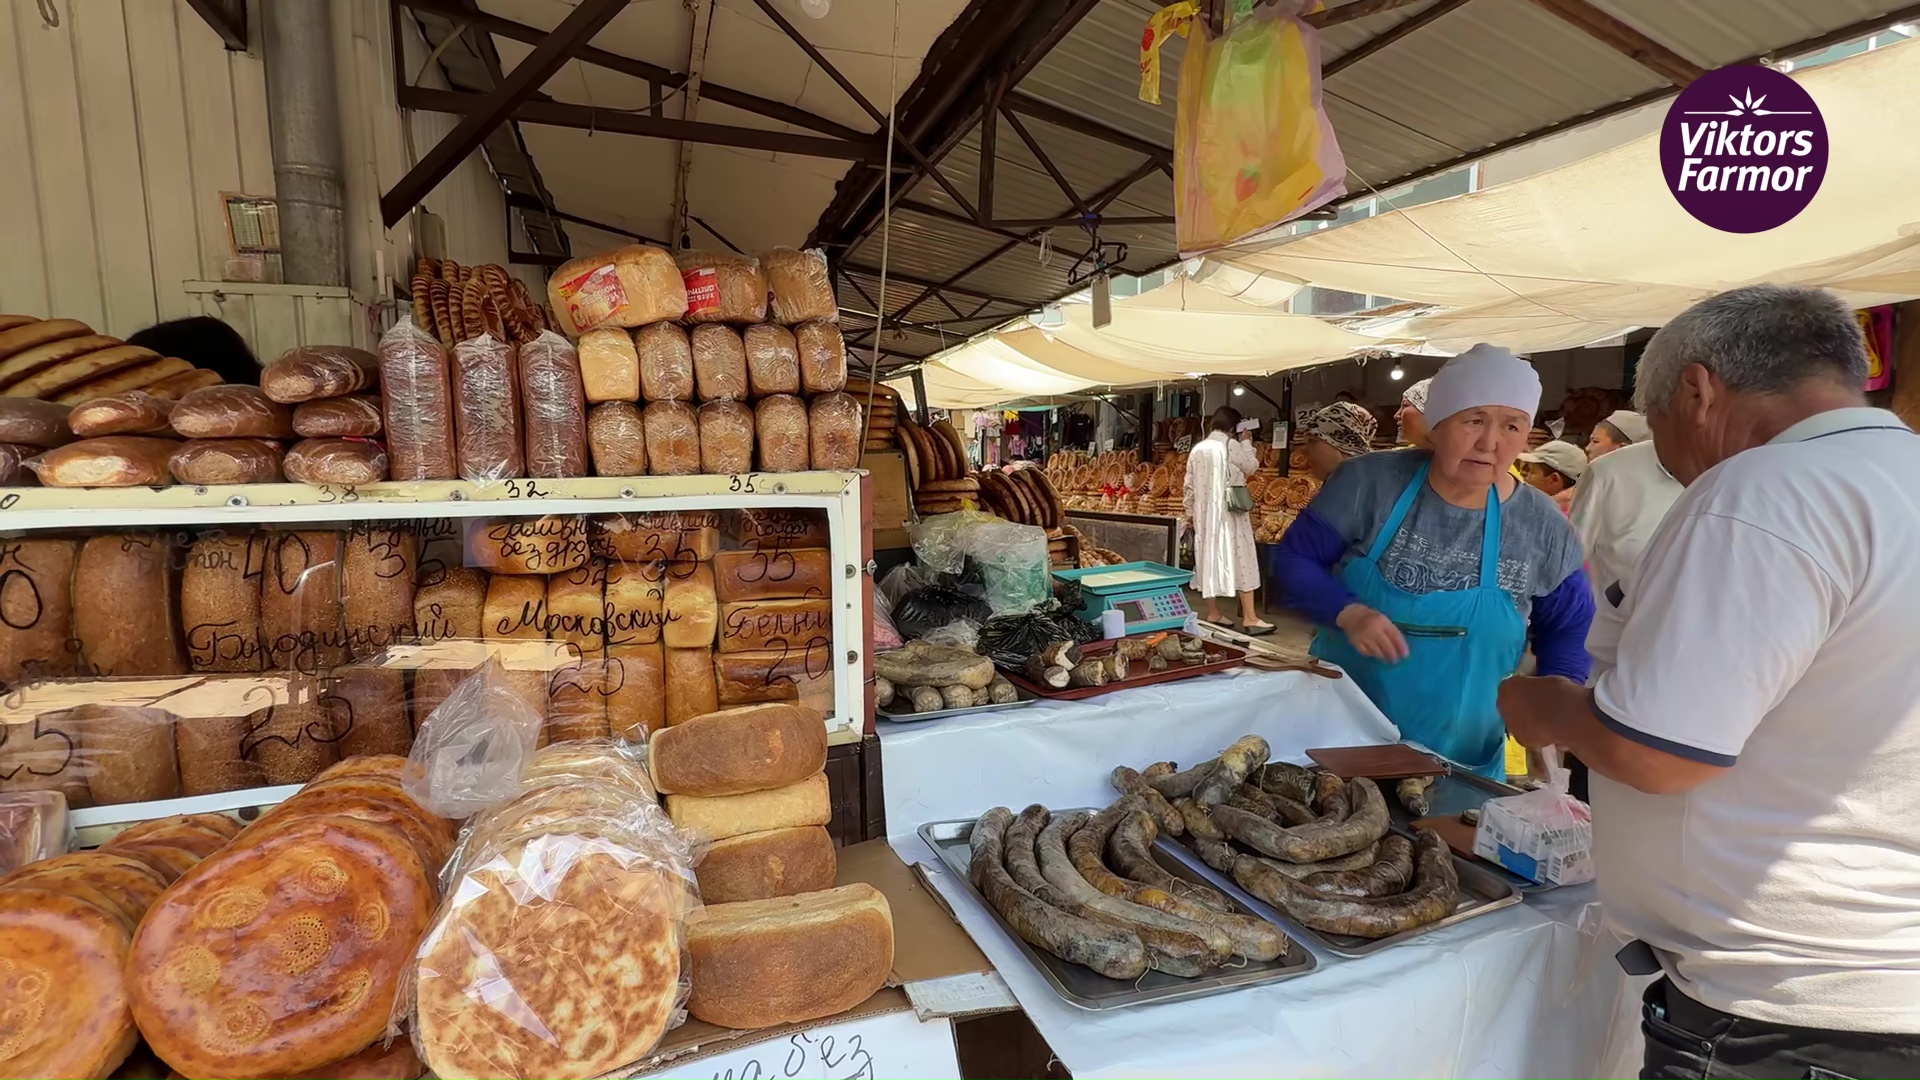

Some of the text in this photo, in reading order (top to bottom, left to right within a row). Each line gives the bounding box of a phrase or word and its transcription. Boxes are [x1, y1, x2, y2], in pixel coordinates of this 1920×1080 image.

[504, 480, 547, 499] 32
[729, 473, 758, 493] 35
[243, 532, 311, 602] 40
[368, 536, 455, 588] 35
[567, 553, 623, 587] 32
[641, 533, 698, 581] 35
[737, 536, 800, 583] 35
[496, 587, 682, 638] Московский
[548, 635, 637, 696] 25
[764, 636, 830, 687] 20
[240, 676, 353, 761] 25
